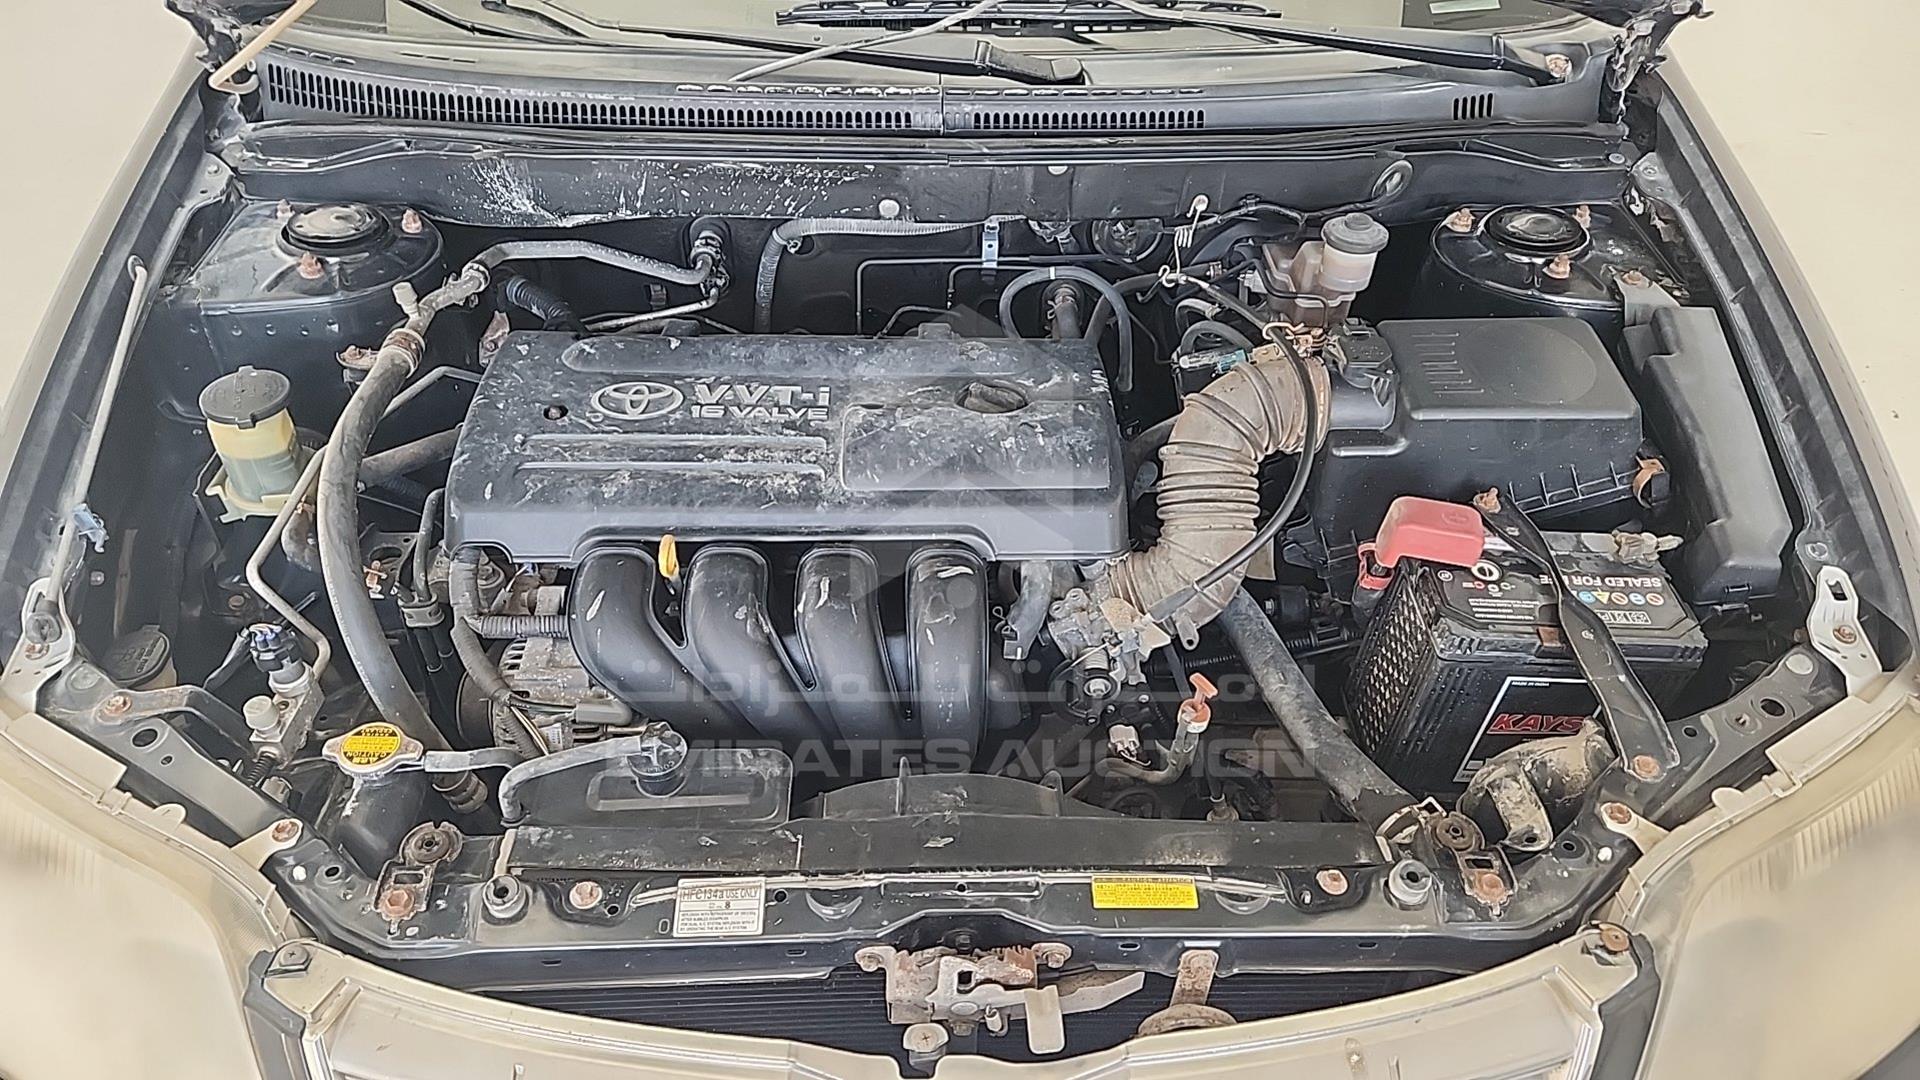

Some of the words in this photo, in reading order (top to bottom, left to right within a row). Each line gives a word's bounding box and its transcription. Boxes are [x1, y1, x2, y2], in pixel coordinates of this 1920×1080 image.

[691, 405, 725, 418] 16
[729, 405, 829, 420] VALVE
[1572, 575, 1602, 587] FOR
[1605, 577, 1662, 588] SEALED
[1489, 714, 1585, 733] KAYS
[682, 888, 724, 900] HFC134a
[725, 887, 739, 899] USE
[740, 886, 758, 899] ONLY
[724, 901, 731, 910] 8
